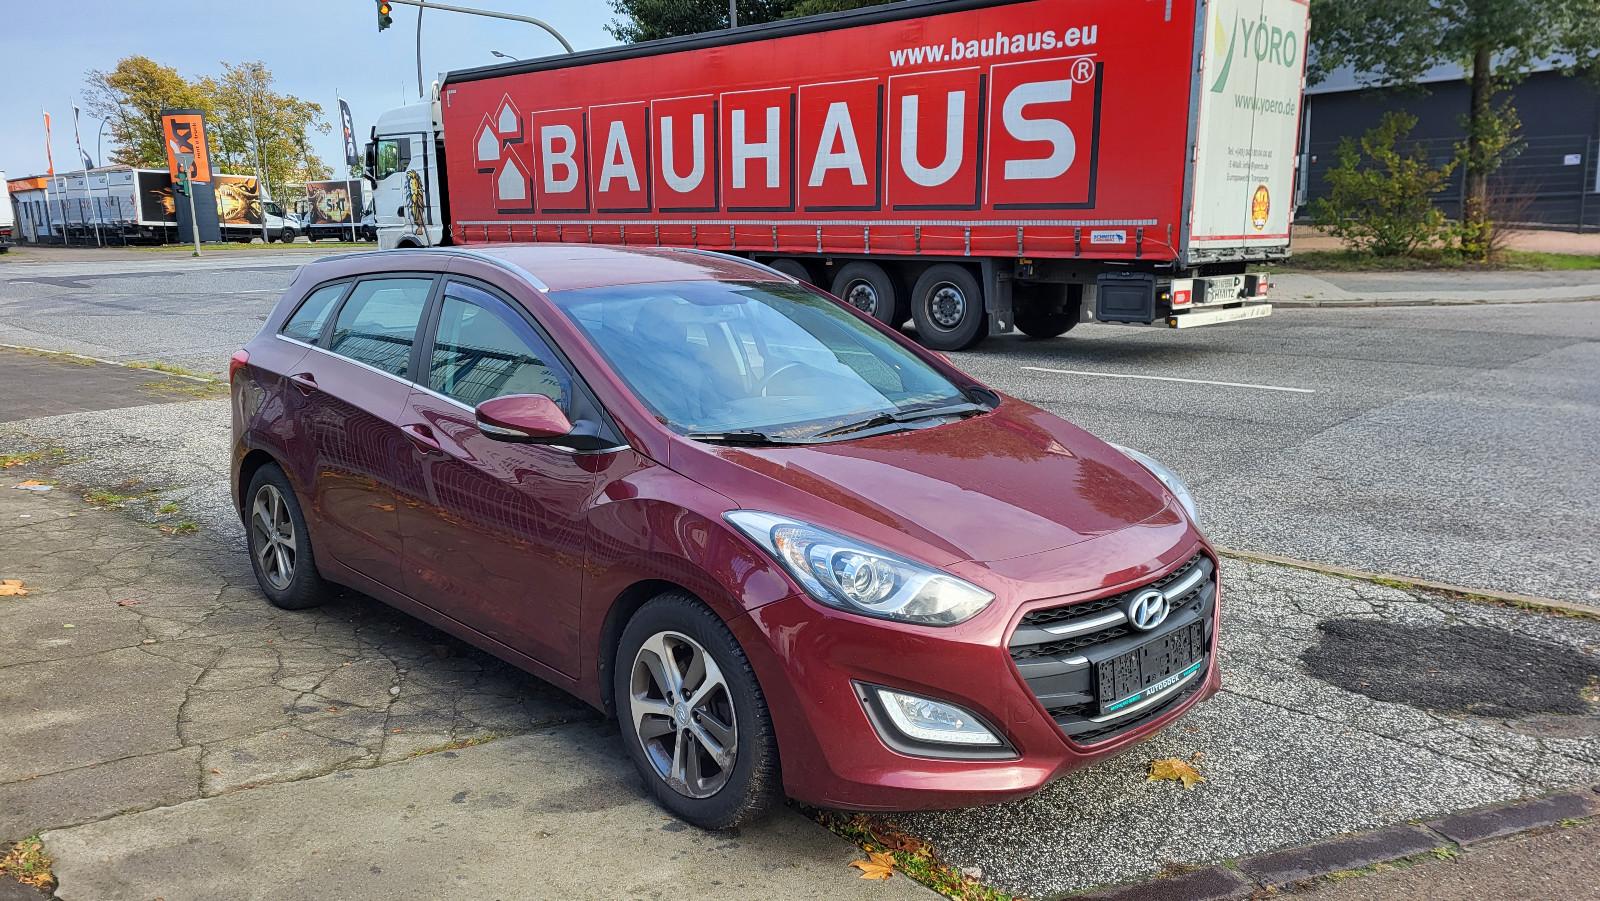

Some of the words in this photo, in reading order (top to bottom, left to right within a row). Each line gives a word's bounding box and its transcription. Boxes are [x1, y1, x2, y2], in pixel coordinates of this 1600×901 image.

[889, 25, 1098, 67] www.bauhaus.eu
[1241, 15, 1297, 68] YÖRO
[1234, 93, 1296, 116] www.yoero.de
[541, 78, 1076, 194] BAUHAUS
[1146, 674, 1180, 696] AUTODOCK
